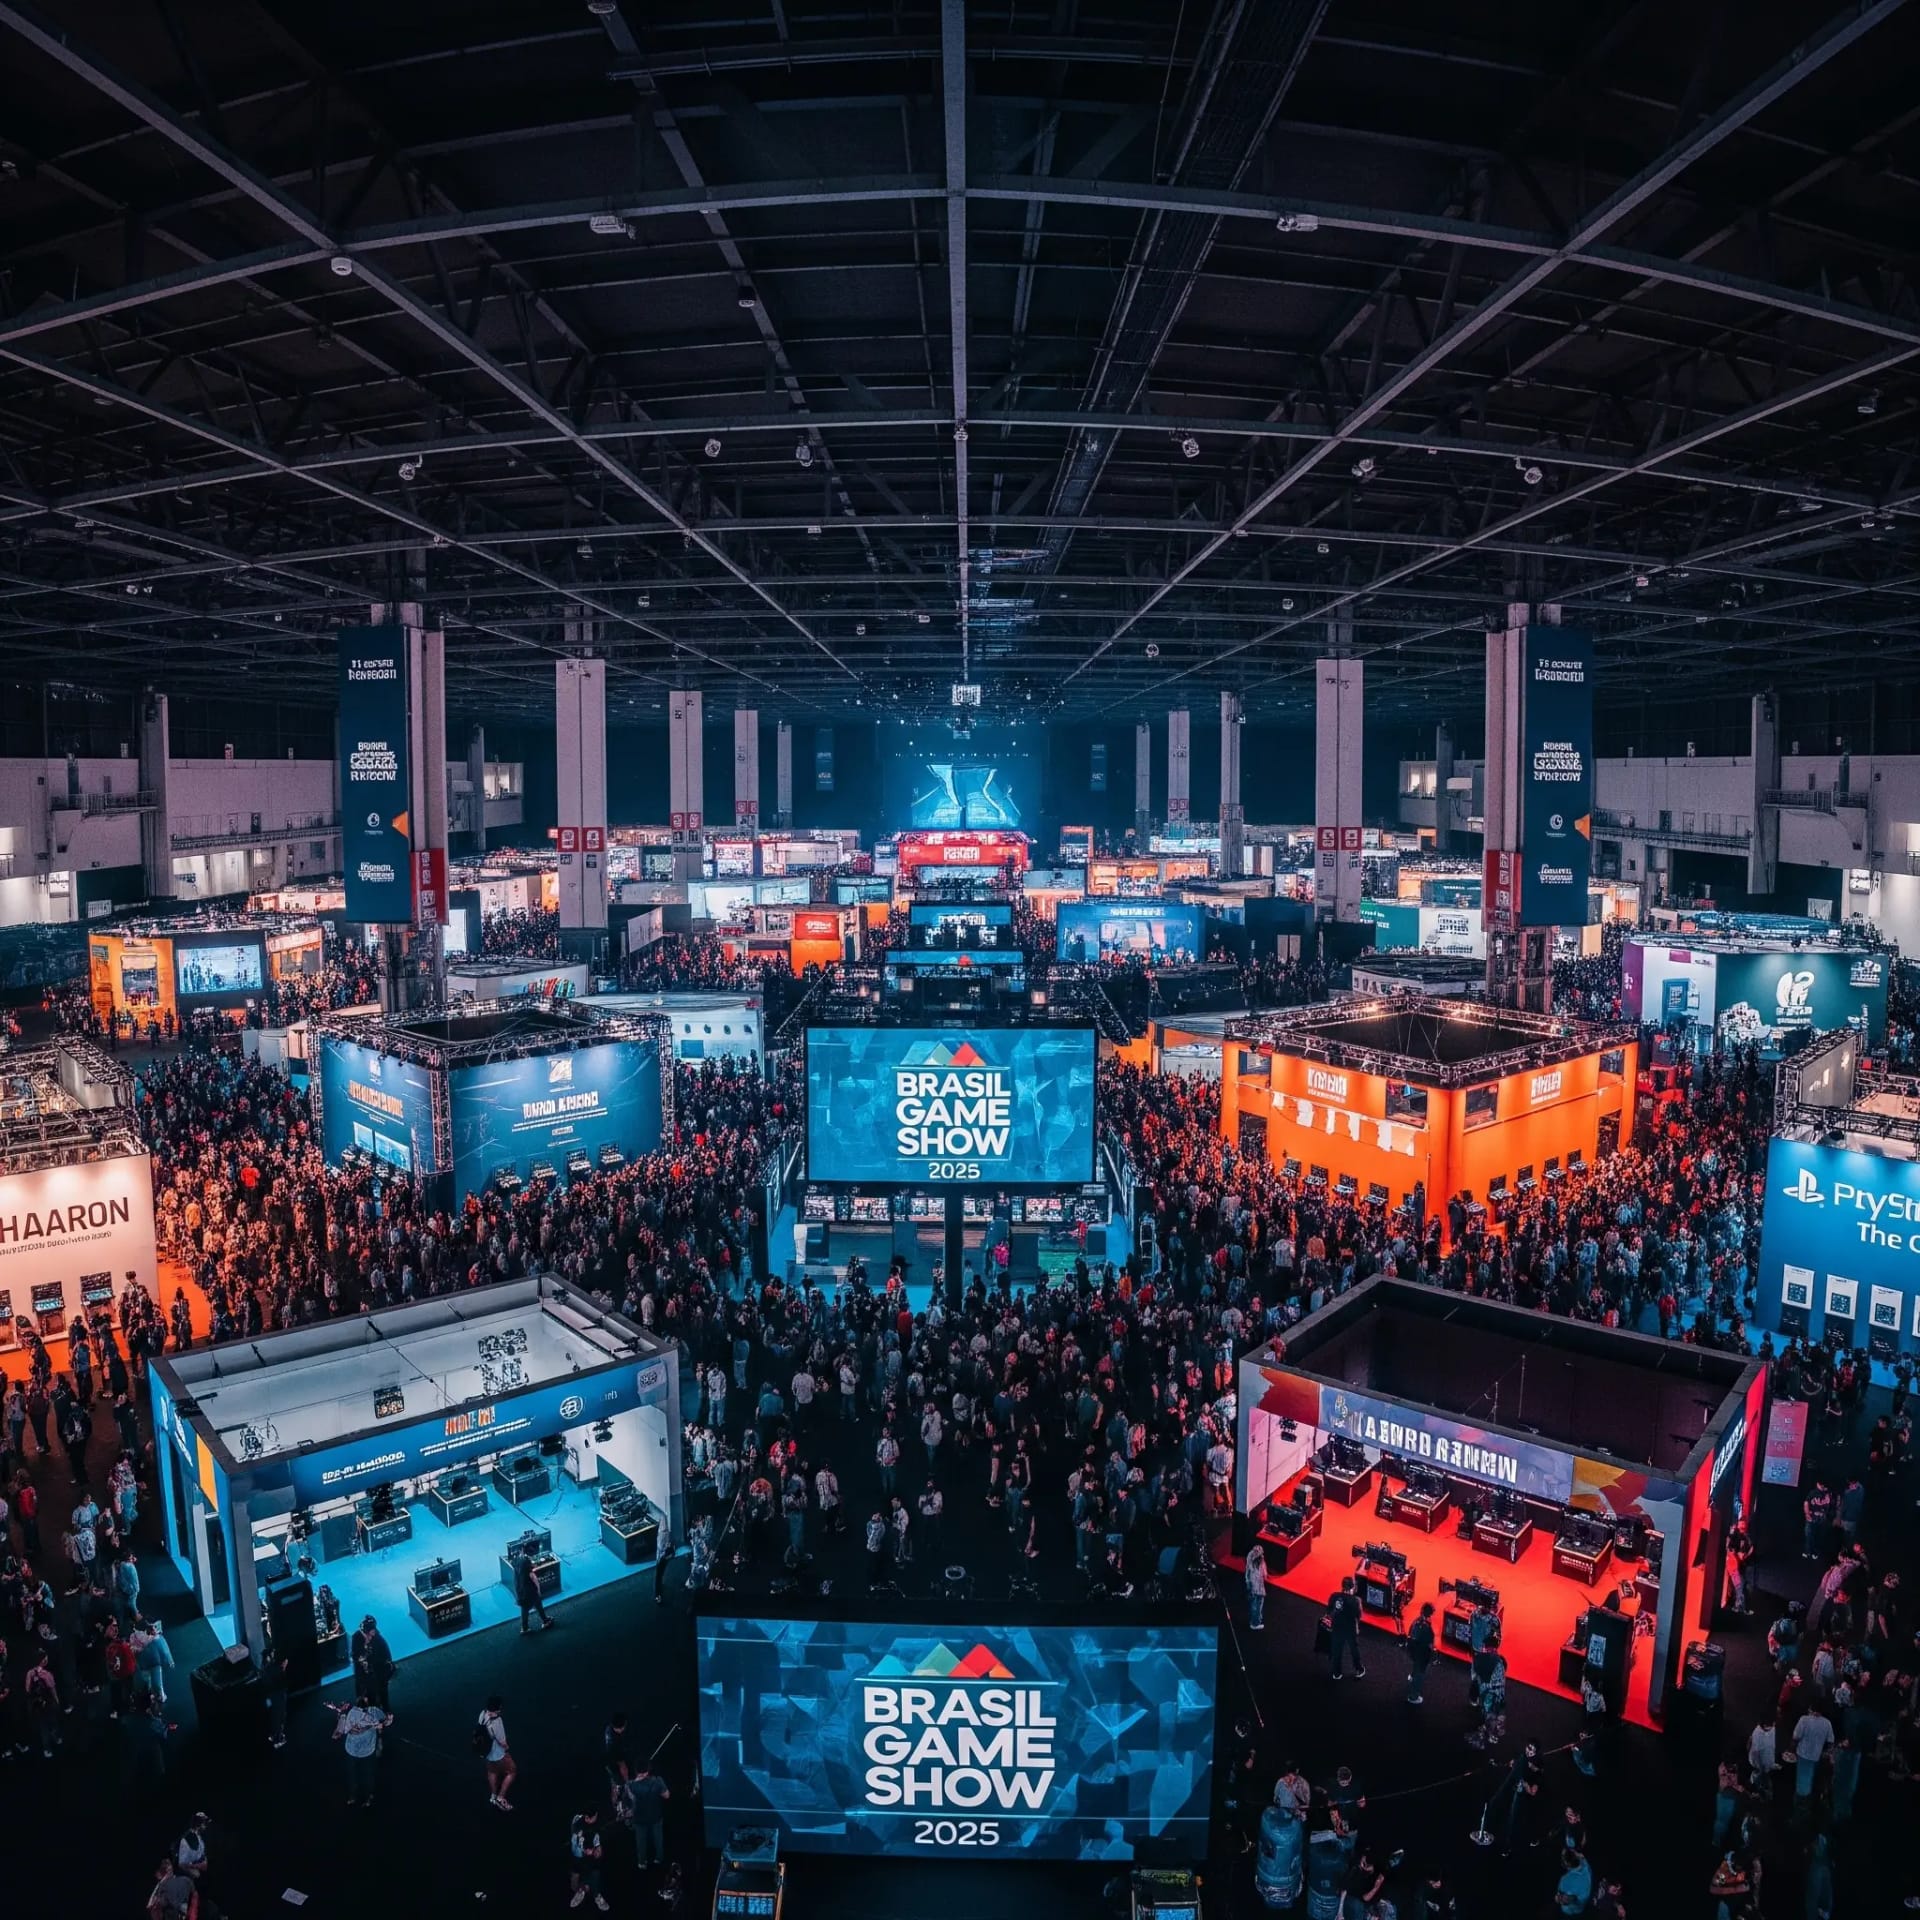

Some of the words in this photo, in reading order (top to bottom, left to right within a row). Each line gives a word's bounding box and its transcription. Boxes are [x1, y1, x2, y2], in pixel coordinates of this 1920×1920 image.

[896, 1072, 1011, 1097] BRASIL
[896, 1098, 1011, 1126] GAME
[897, 1127, 1010, 1155] SHOW
[928, 1162, 981, 1179] 2025
[1857, 1221, 1902, 1249] The
[863, 1686, 1057, 1727] BRASIL
[863, 1725, 1056, 1768] GAME
[865, 1766, 1055, 1809] SHOW
[914, 1820, 1000, 1846] 2025
